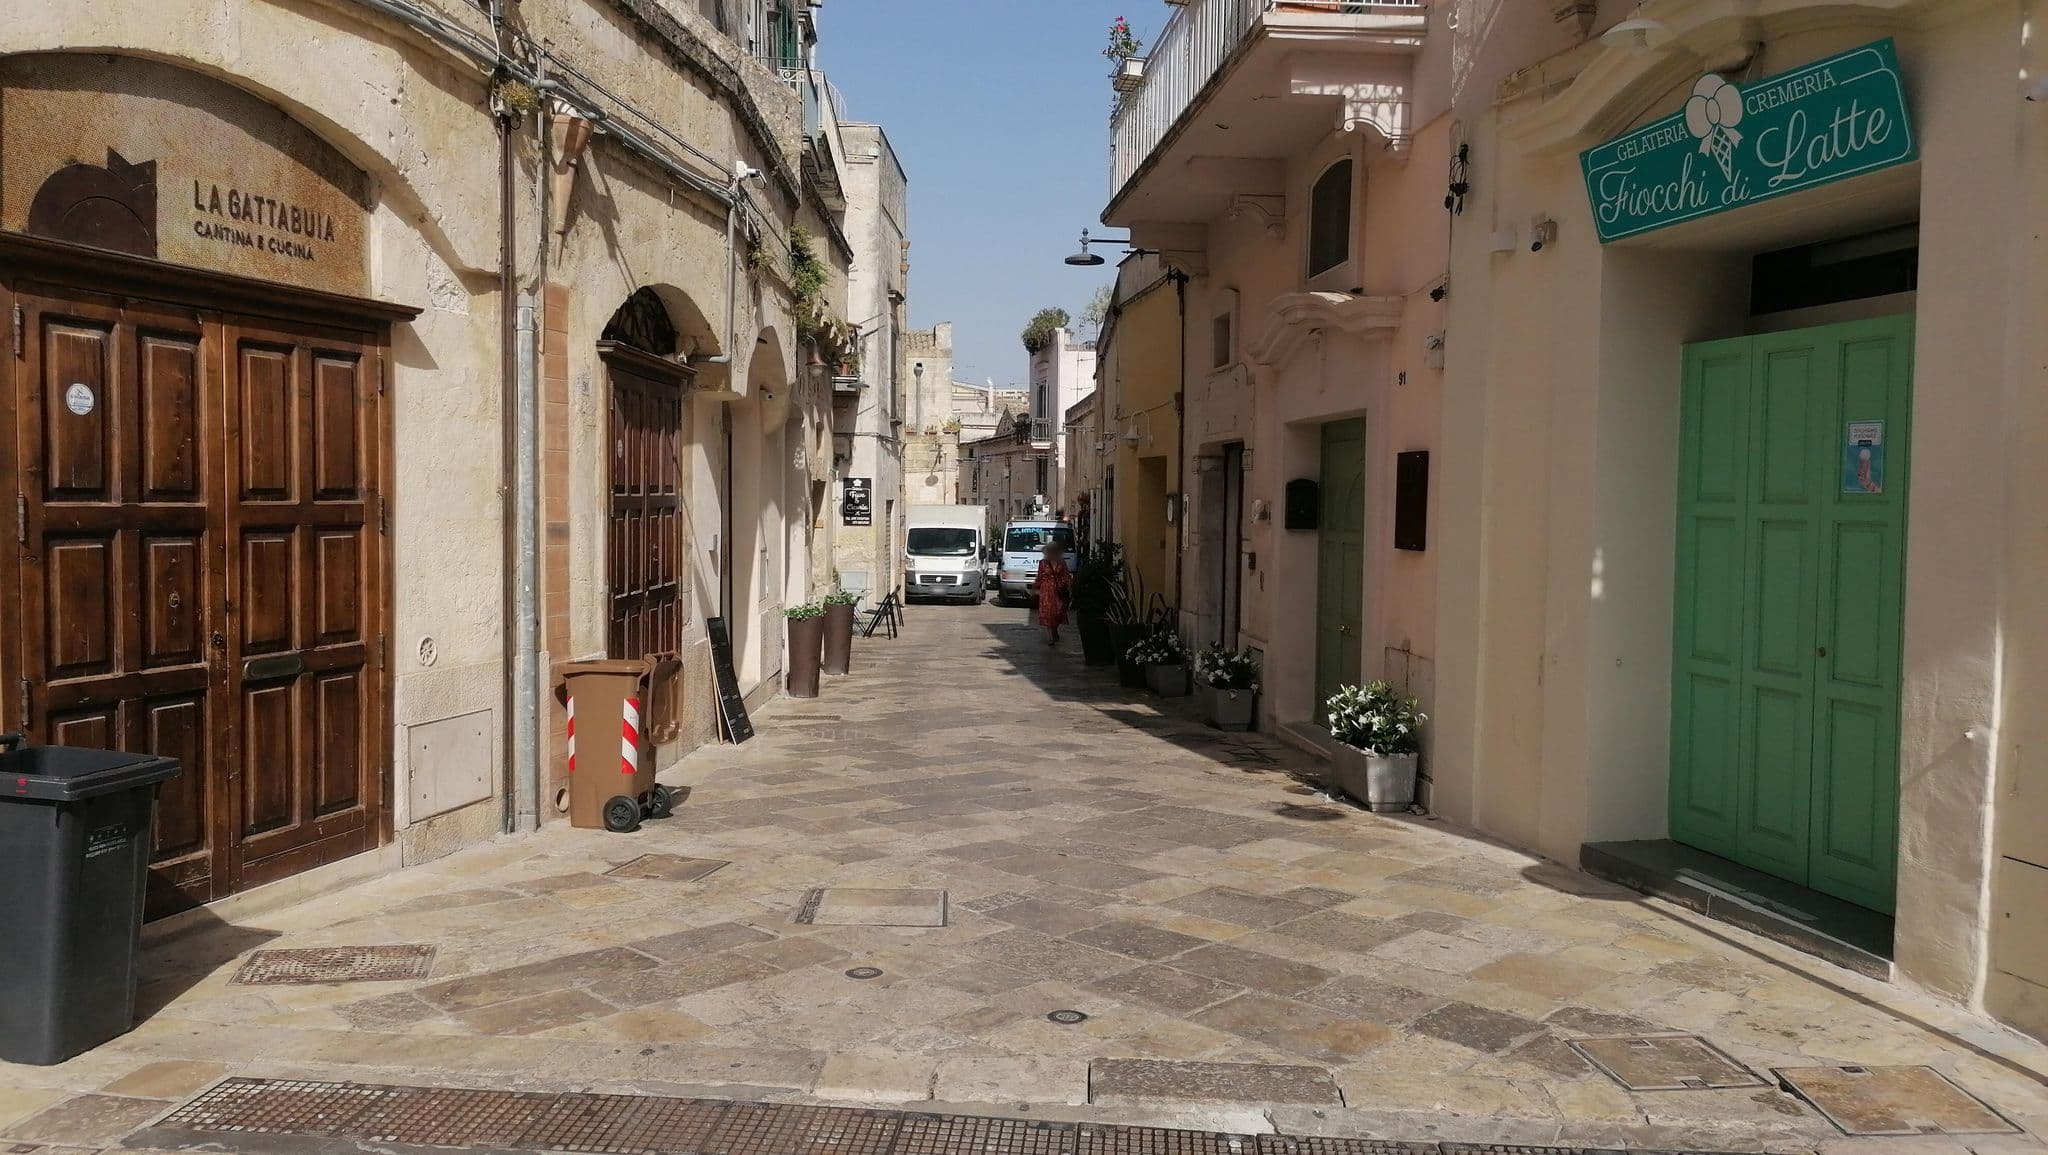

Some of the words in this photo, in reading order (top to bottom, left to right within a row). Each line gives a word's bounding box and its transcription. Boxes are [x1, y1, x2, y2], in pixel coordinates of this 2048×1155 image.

[1746, 68, 1838, 115] CREMERIA
[1598, 152, 1709, 224] Fiocchi
[1720, 169, 1750, 205] di
[1756, 99, 1892, 188] Latte
[1616, 123, 1688, 162] GELATERIA
[194, 179, 223, 217] LA
[228, 188, 335, 243] GATTABUIA
[193, 220, 253, 249] CANTINA
[257, 234, 264, 251] E
[268, 237, 314, 261] CUCINA
[1398, 371, 1406, 386] 91
